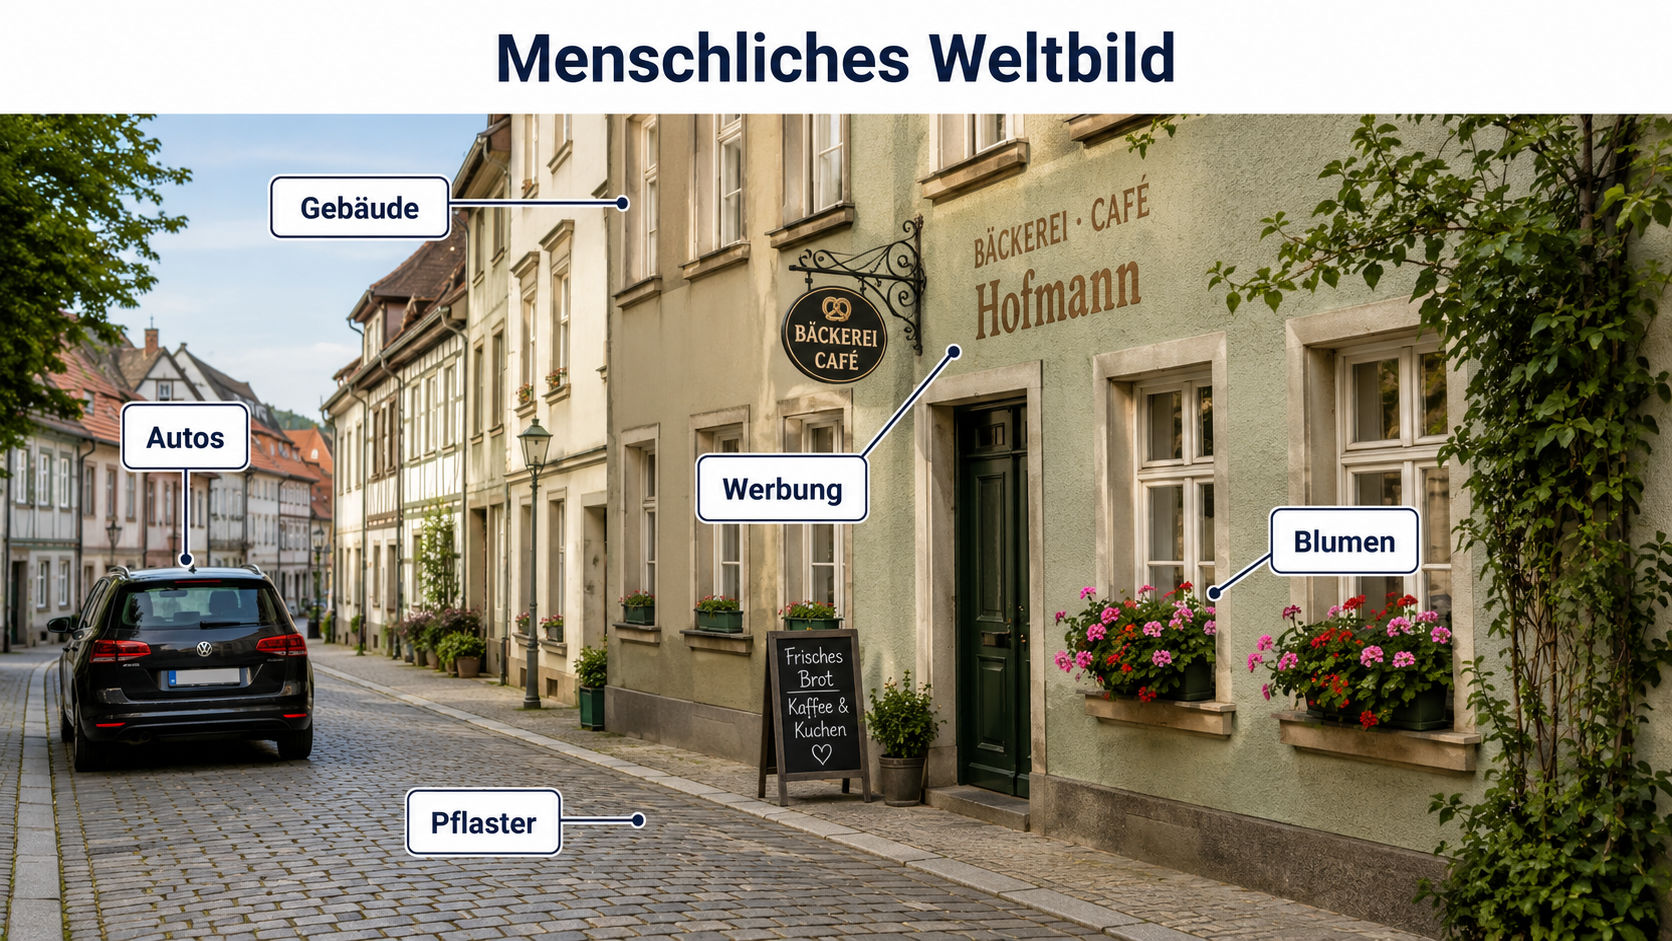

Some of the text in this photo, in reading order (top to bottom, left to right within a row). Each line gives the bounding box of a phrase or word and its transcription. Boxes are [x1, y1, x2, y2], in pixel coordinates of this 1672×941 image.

[974, 210, 1068, 269] BÄCKEREI
[1091, 174, 1150, 232] CAFÉ
[976, 261, 1142, 340] Hofmann
[794, 320, 879, 348] BÄCKEREI
[814, 349, 860, 371] CAFÉ
[197, 641, 213, 657] VW
[784, 646, 844, 666] Frisches
[797, 669, 834, 688] Brot
[788, 696, 850, 719] Kaffee &
[794, 720, 847, 739] Kuchen
